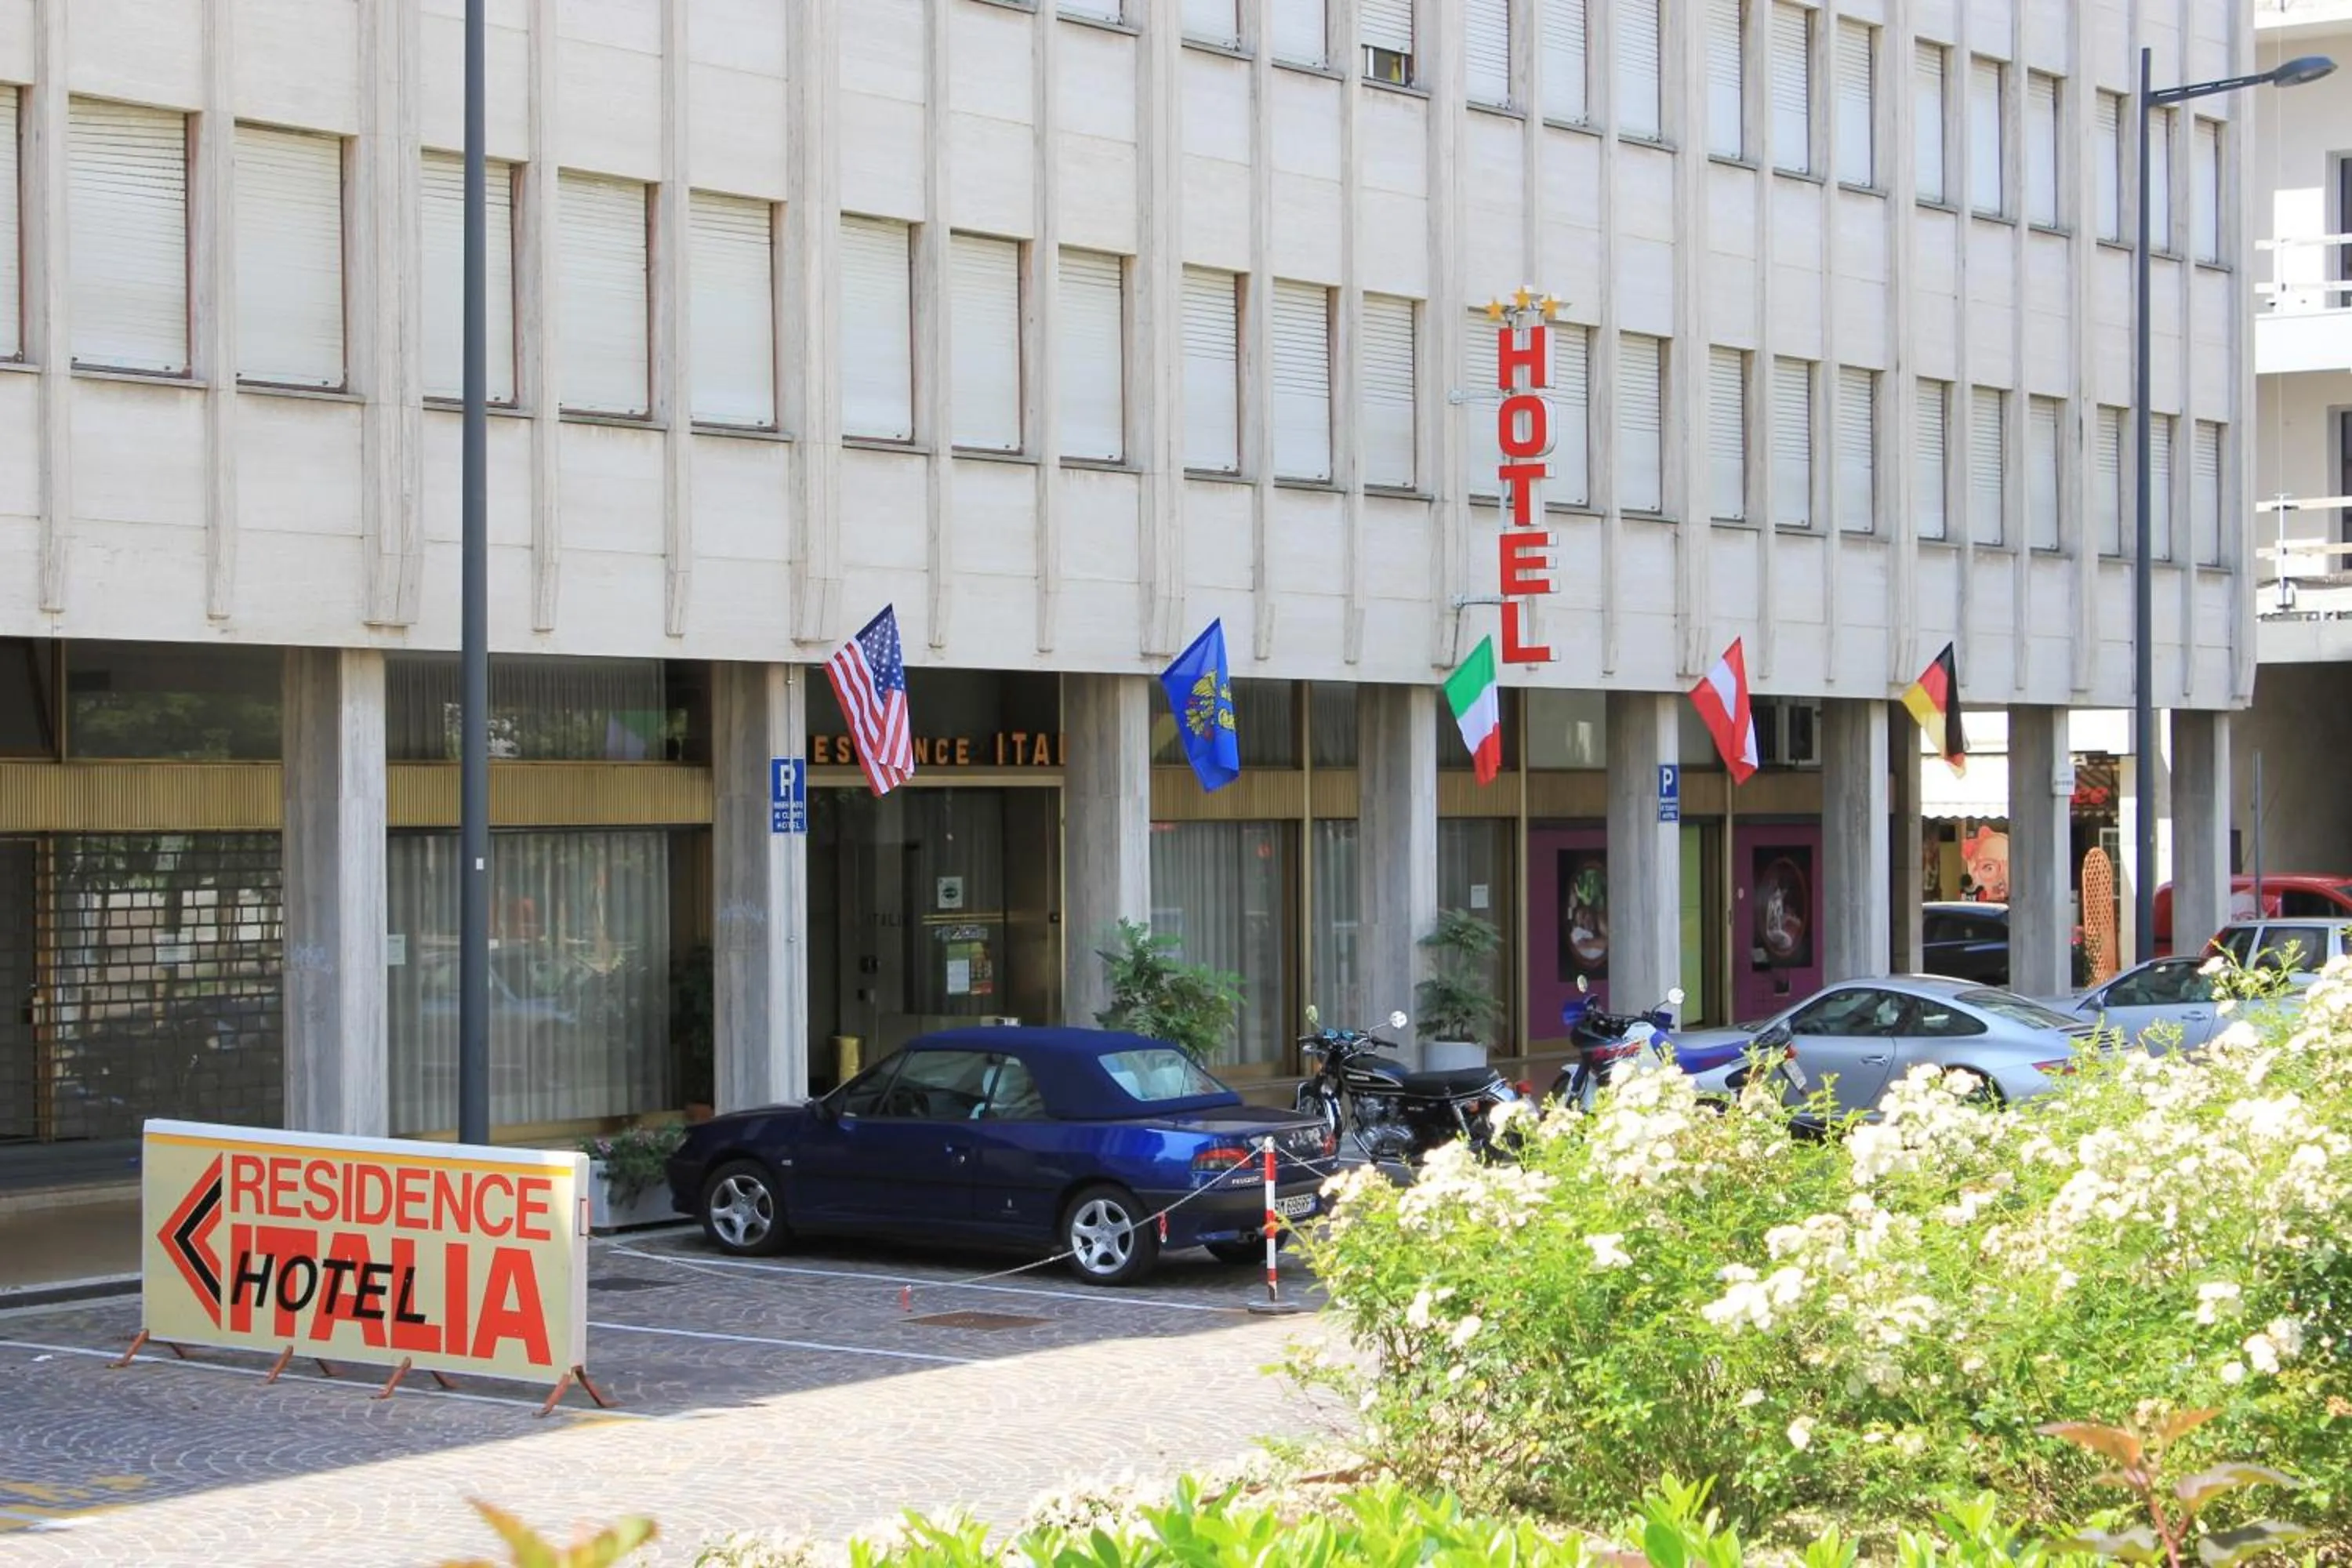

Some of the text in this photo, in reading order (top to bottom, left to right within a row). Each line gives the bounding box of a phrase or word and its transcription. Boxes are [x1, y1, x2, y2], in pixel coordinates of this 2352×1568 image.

[1498, 325, 1551, 663] HOTEL
[780, 764, 797, 797] P
[814, 732, 1065, 765] ESNCE ITA
[1663, 768, 1674, 794] P
[230, 1154, 552, 1240] RESIDENCE
[230, 1223, 552, 1366] ITALIA
[231, 1251, 426, 1324] HOTEL
